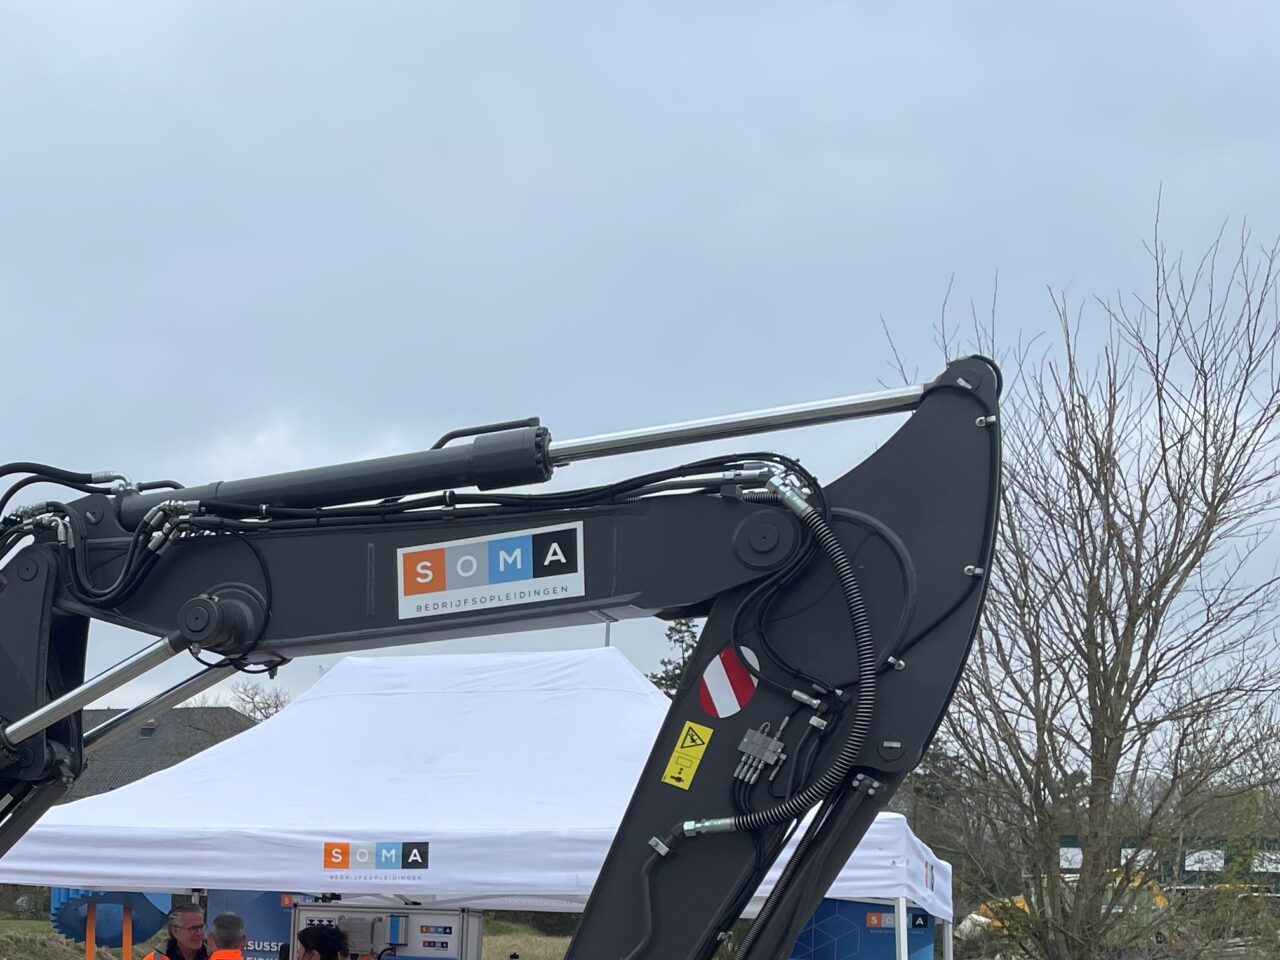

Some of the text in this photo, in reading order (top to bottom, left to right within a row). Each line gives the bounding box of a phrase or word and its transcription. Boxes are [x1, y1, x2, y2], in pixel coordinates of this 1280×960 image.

[416, 542, 567, 584] SOMA
[416, 585, 568, 613] BEDRIJFSOPLEIDINGEN
[331, 848, 422, 863] SOMA
[871, 916, 924, 926] SOA
